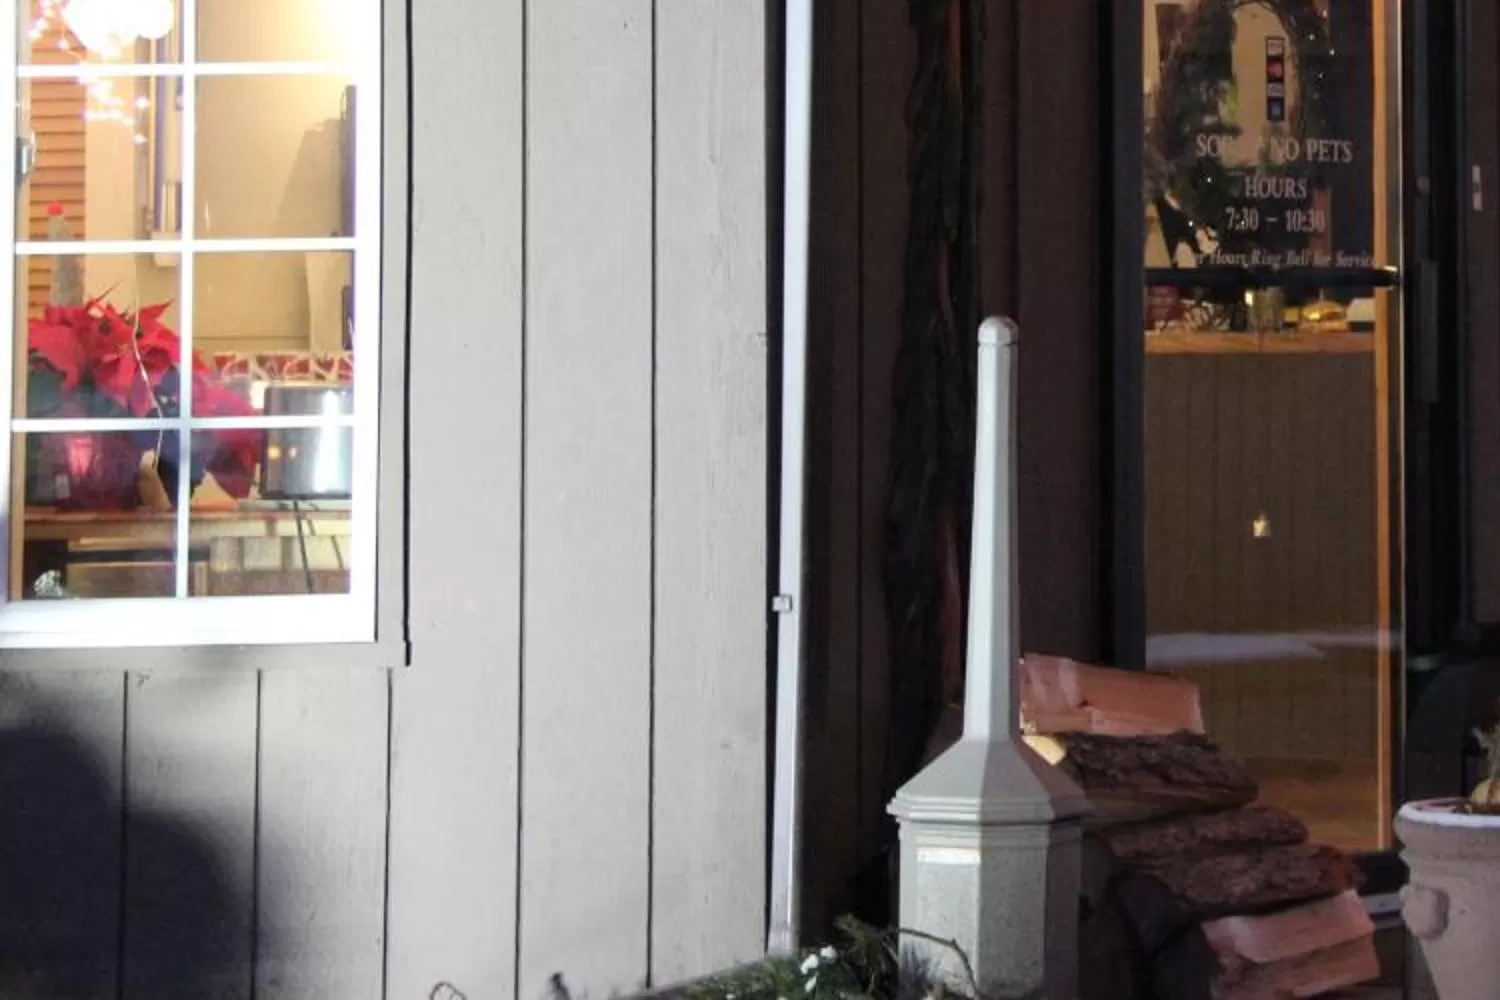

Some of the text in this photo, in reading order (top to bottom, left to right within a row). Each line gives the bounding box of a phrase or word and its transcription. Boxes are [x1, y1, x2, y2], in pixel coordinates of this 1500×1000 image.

[1305, 138, 1354, 163] PETS
[1244, 176, 1308, 199] HOURS
[1225, 206, 1260, 232] 7:30
